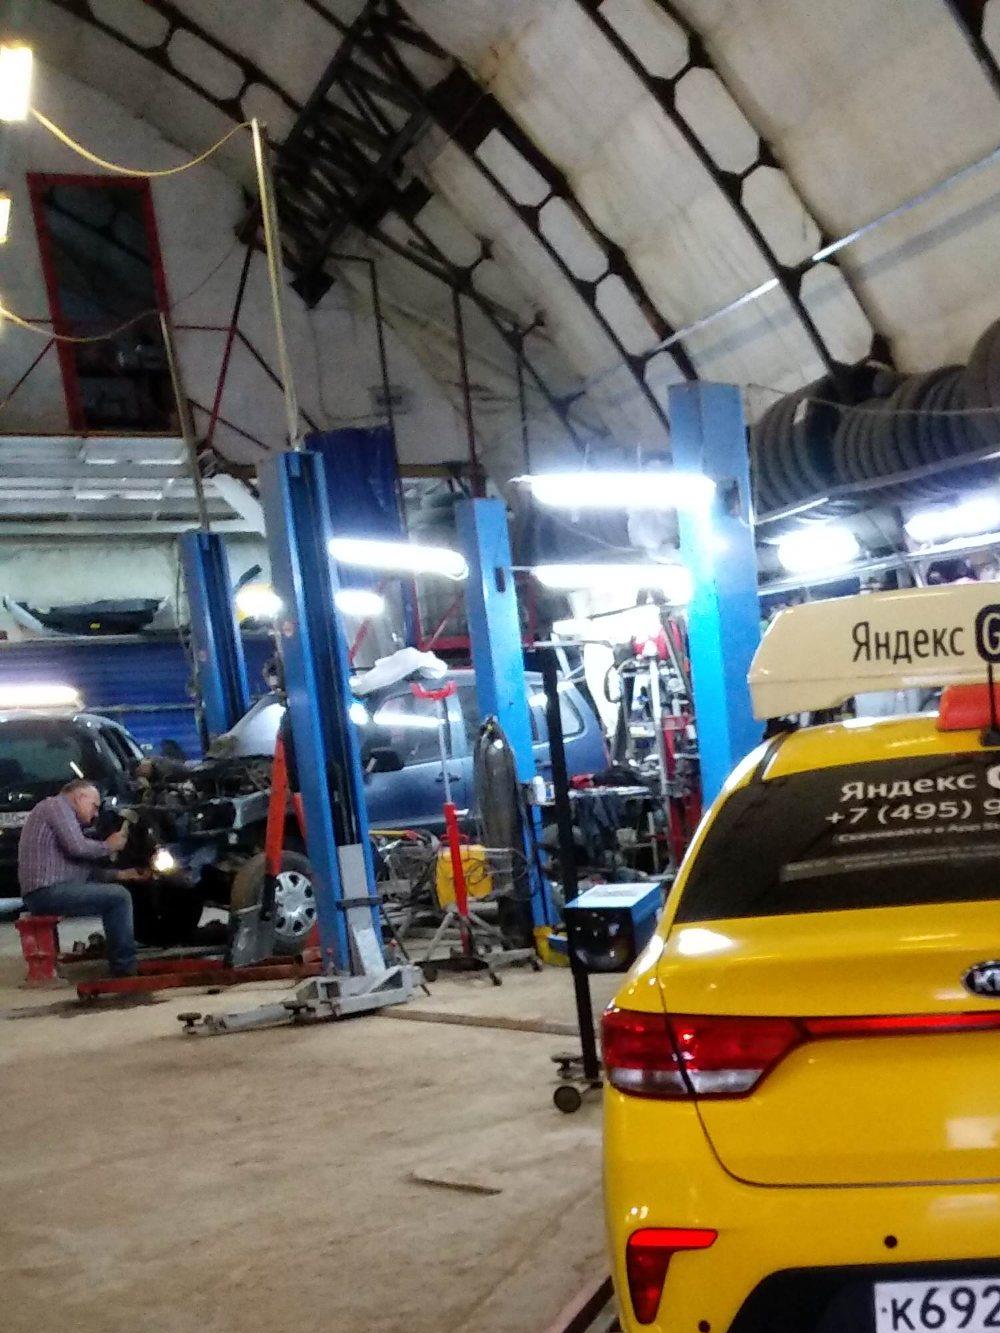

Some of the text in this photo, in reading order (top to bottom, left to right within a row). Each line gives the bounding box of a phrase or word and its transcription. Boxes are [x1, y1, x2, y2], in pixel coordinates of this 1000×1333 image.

[852, 620, 965, 664] Яндекс
[840, 773, 977, 802] Яндекс
[825, 806, 869, 824] +7
[877, 799, 972, 825] (495)
